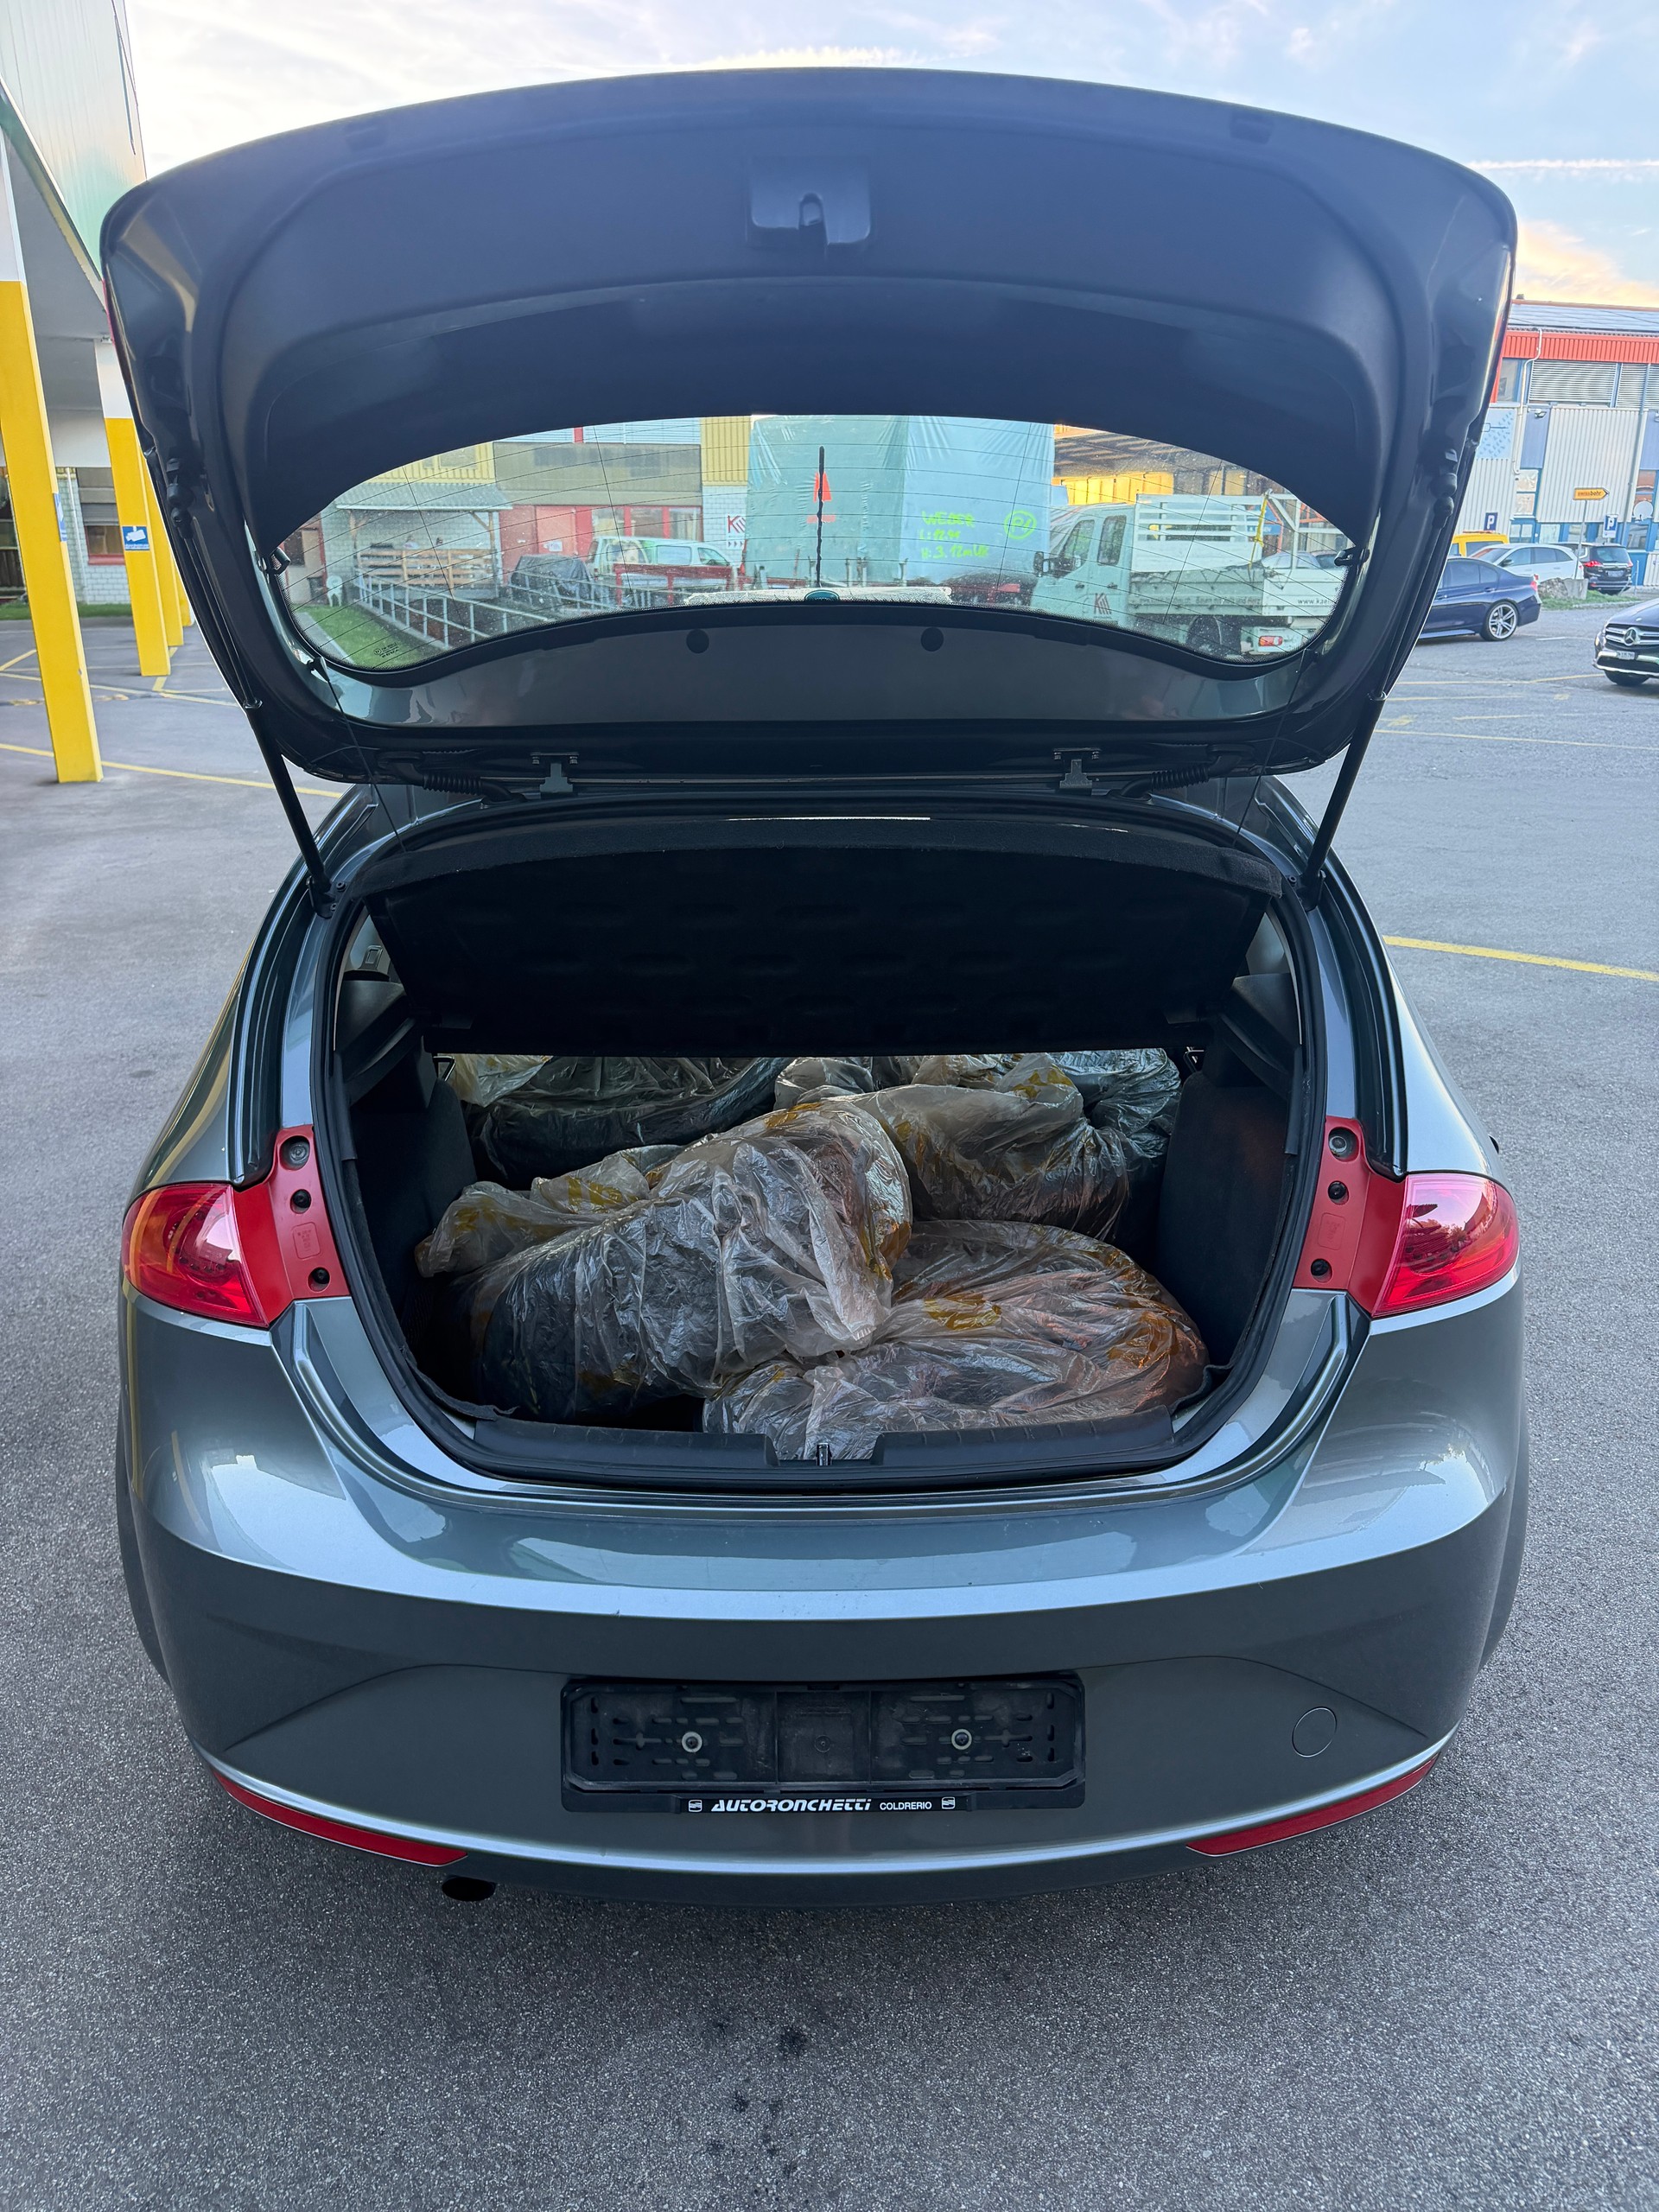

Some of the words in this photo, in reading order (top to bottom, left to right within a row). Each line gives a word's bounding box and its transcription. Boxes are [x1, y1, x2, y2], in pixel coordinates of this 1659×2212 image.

[1486, 515, 1495, 530] P
[1606, 518, 1615, 531] P
[880, 1801, 932, 1810] COLDRERIO
